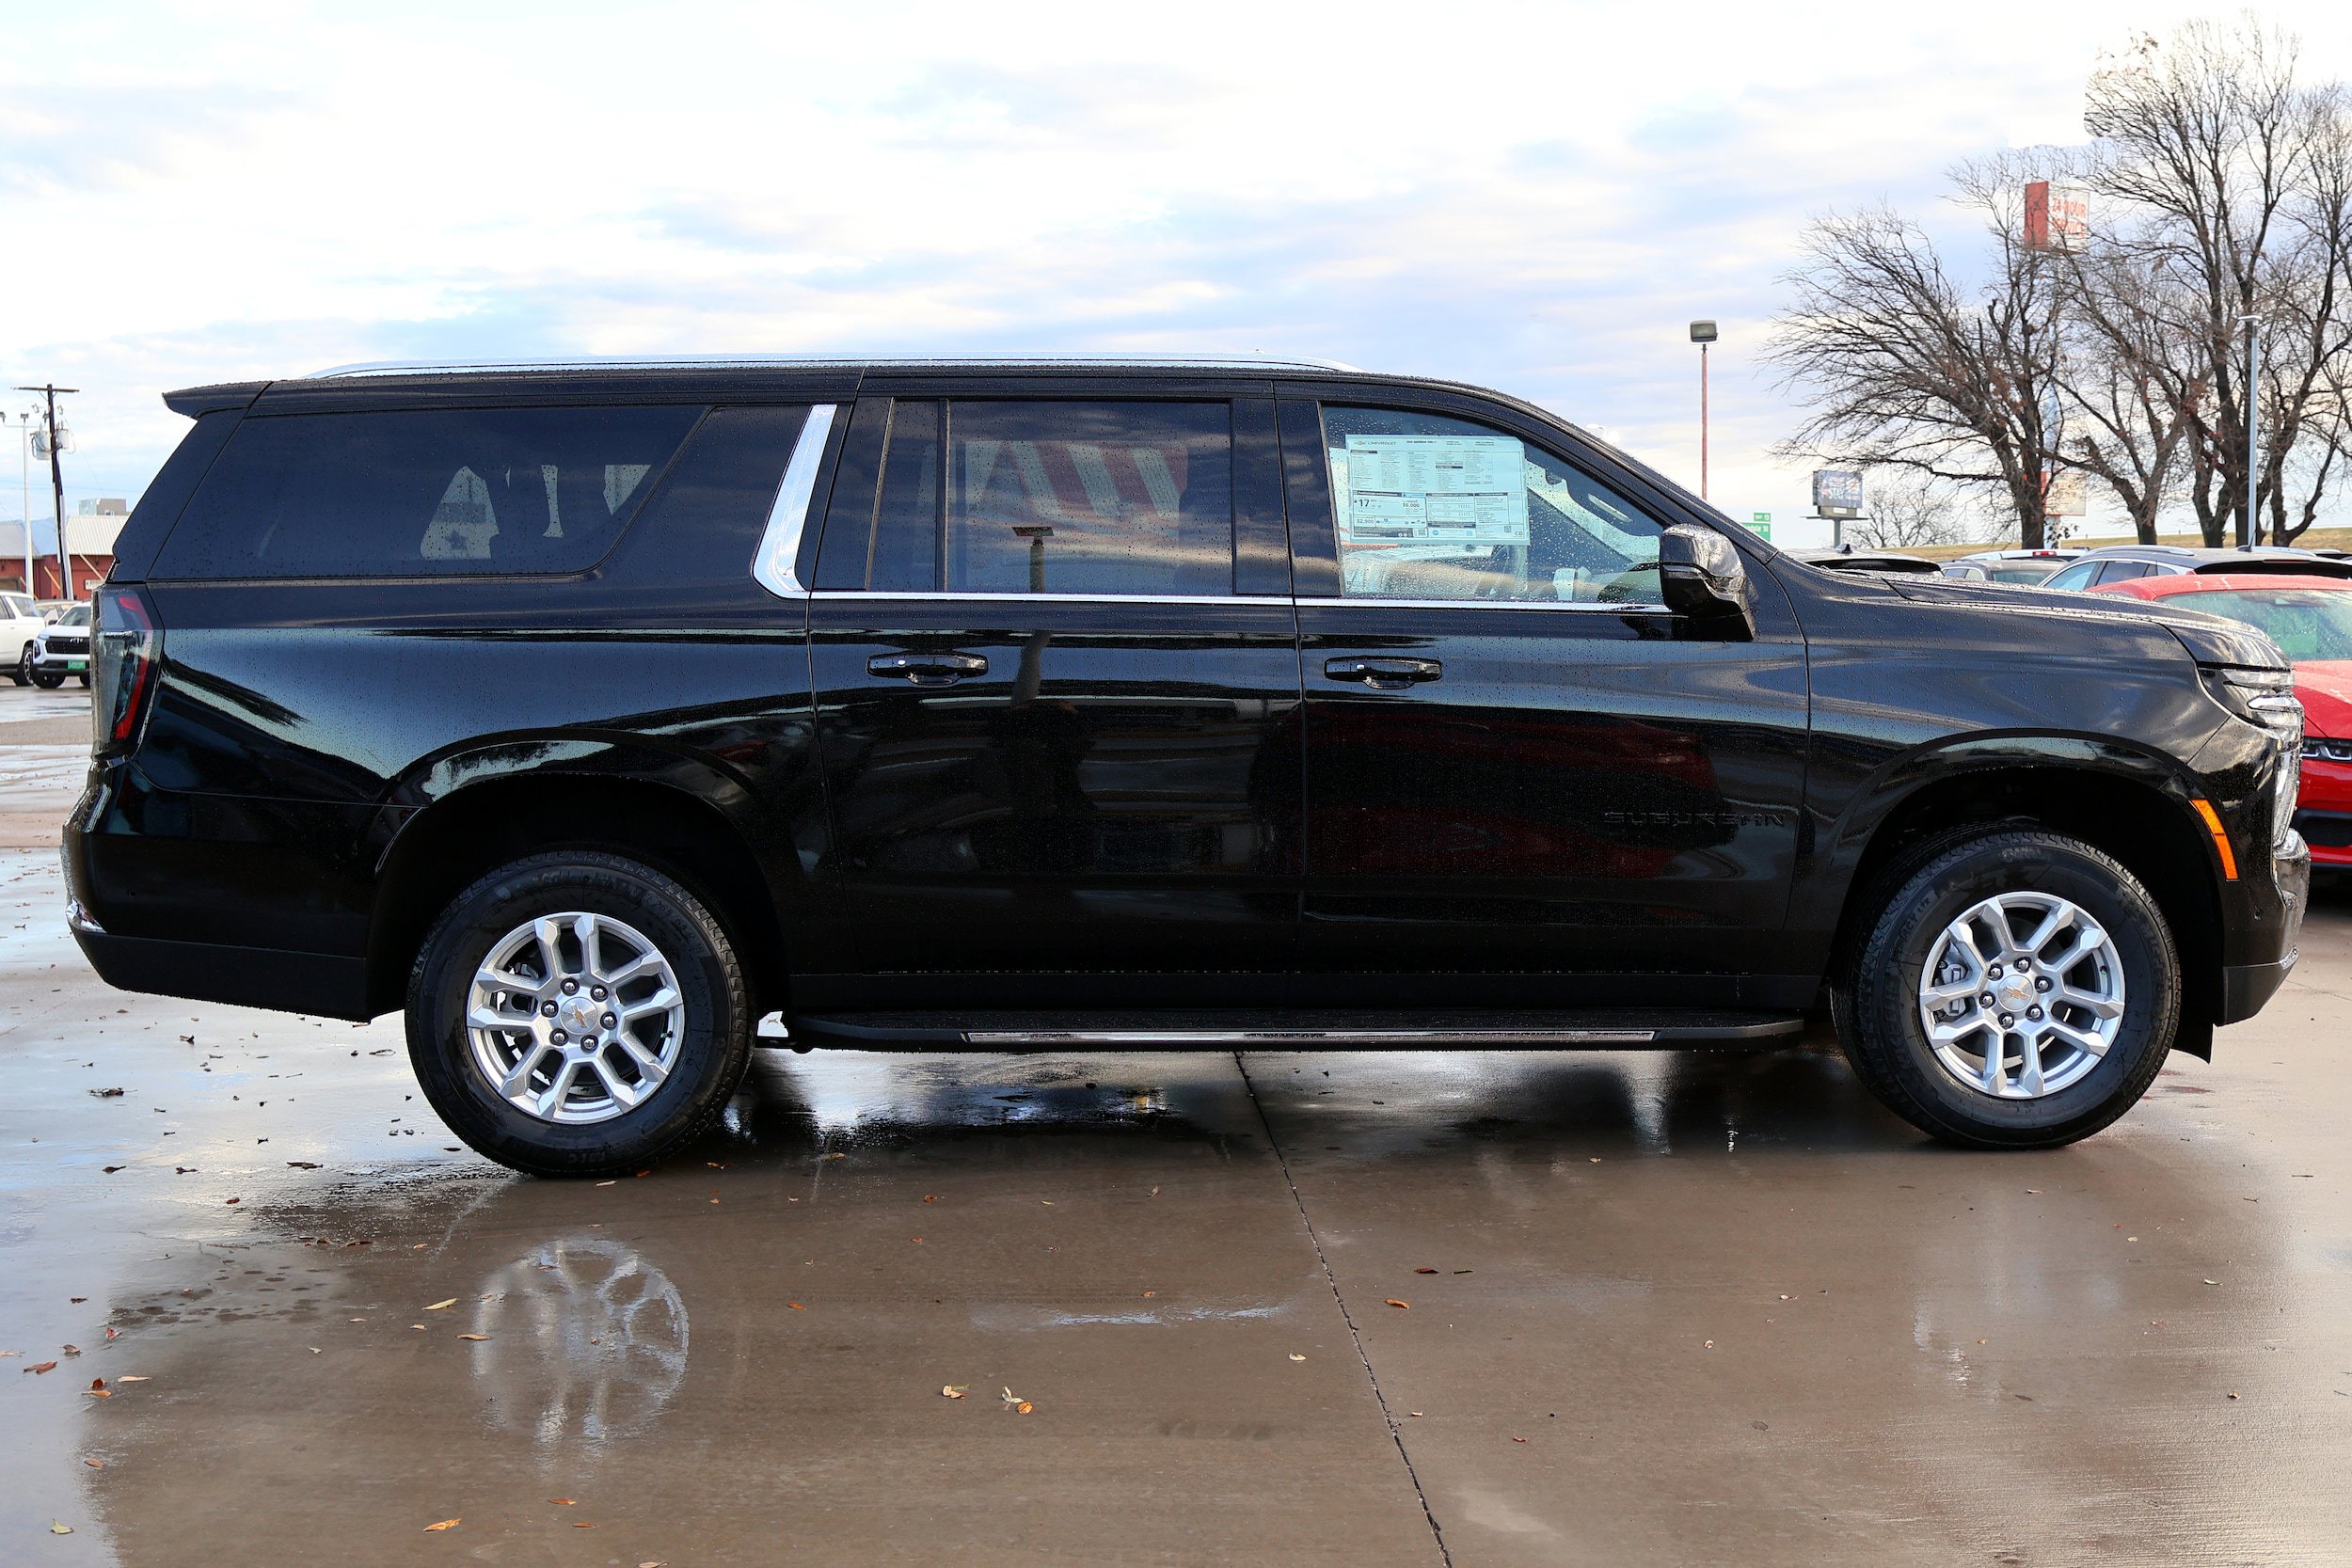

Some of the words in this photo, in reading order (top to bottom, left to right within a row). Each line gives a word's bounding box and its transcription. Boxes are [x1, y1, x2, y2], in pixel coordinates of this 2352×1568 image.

[2052, 196, 2062, 213] 24
[2064, 199, 2086, 218] HOUR
[1604, 812, 1786, 827] SUBURBAN
